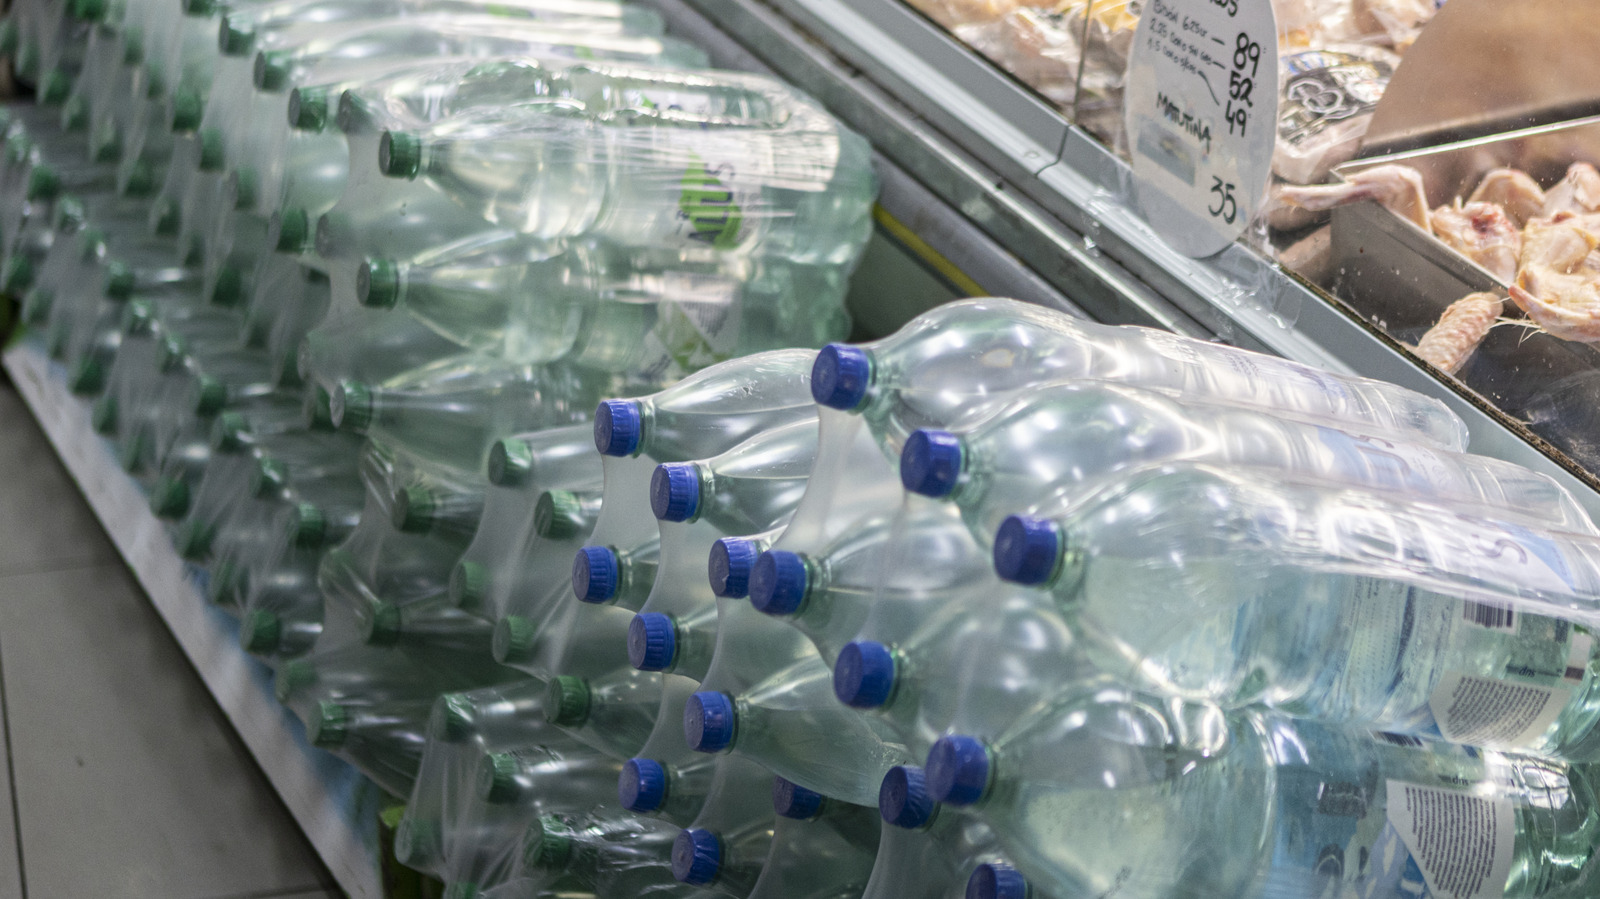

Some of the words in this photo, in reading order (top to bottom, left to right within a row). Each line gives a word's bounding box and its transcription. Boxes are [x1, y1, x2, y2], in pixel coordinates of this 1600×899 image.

[1233, 32, 1260, 78] 89
[1229, 70, 1253, 107] 52
[1225, 100, 1247, 137] 49
[1208, 175, 1237, 224] 35
